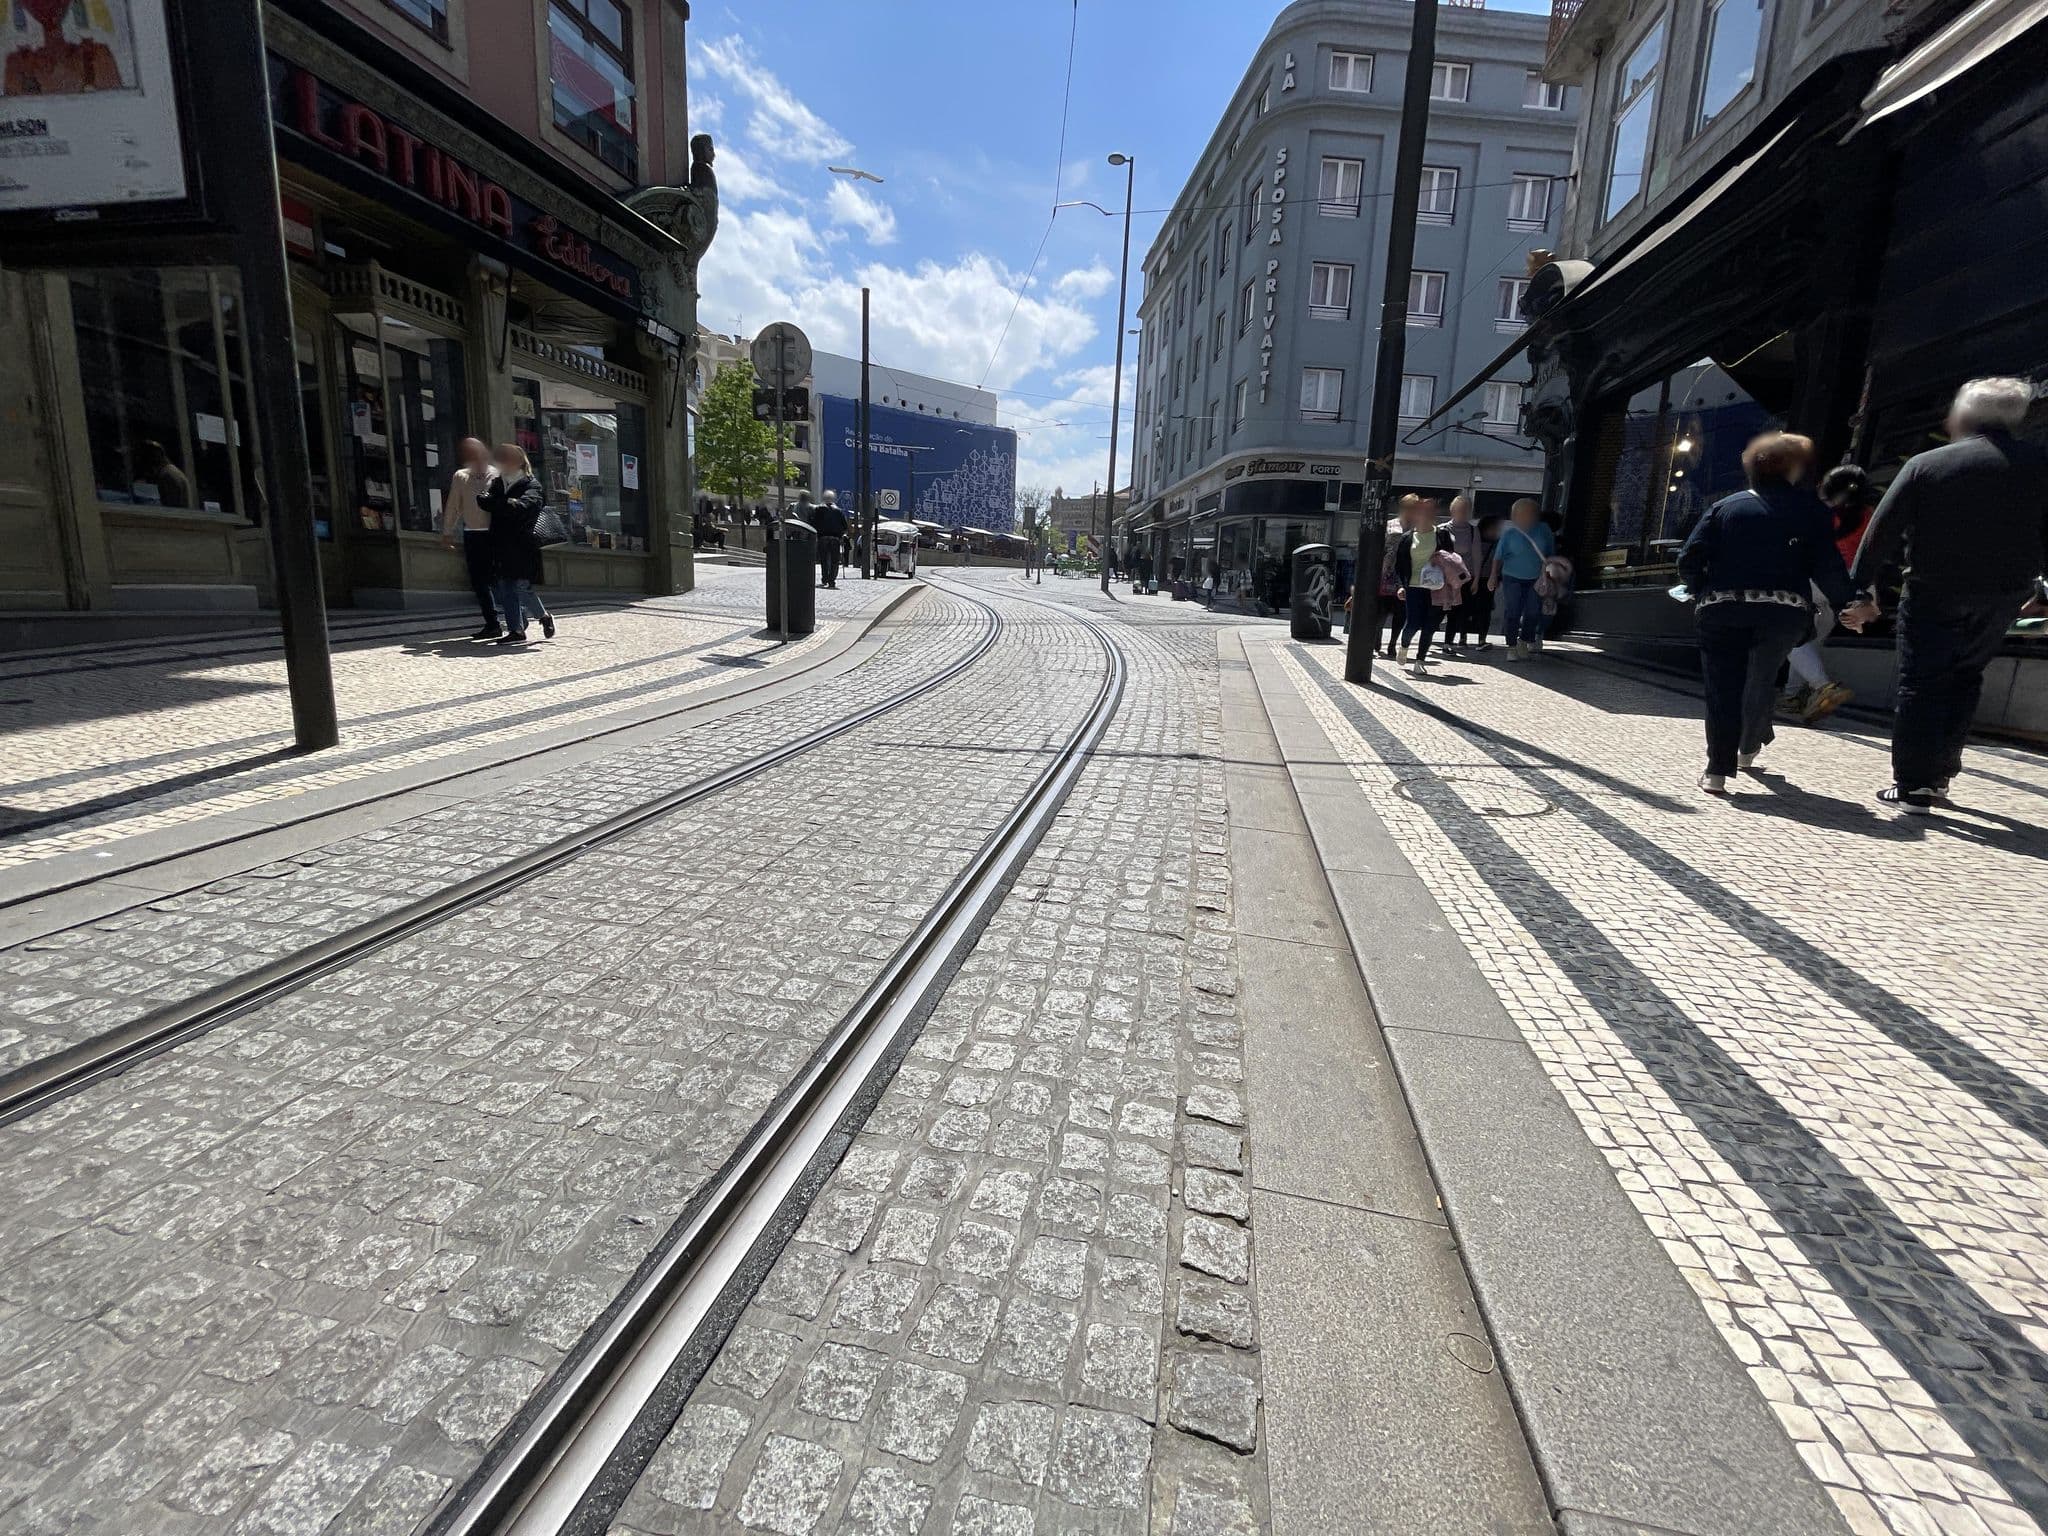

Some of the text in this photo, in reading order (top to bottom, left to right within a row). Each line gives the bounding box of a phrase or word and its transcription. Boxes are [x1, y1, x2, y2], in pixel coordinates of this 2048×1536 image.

[296, 70, 513, 238] LATINA
[529, 214, 633, 298] Editora
[1259, 53, 1296, 404] LA SPOSA PRIVATTI
[879, 445, 909, 457] Batalha
[1311, 464, 1341, 476] PORTO
